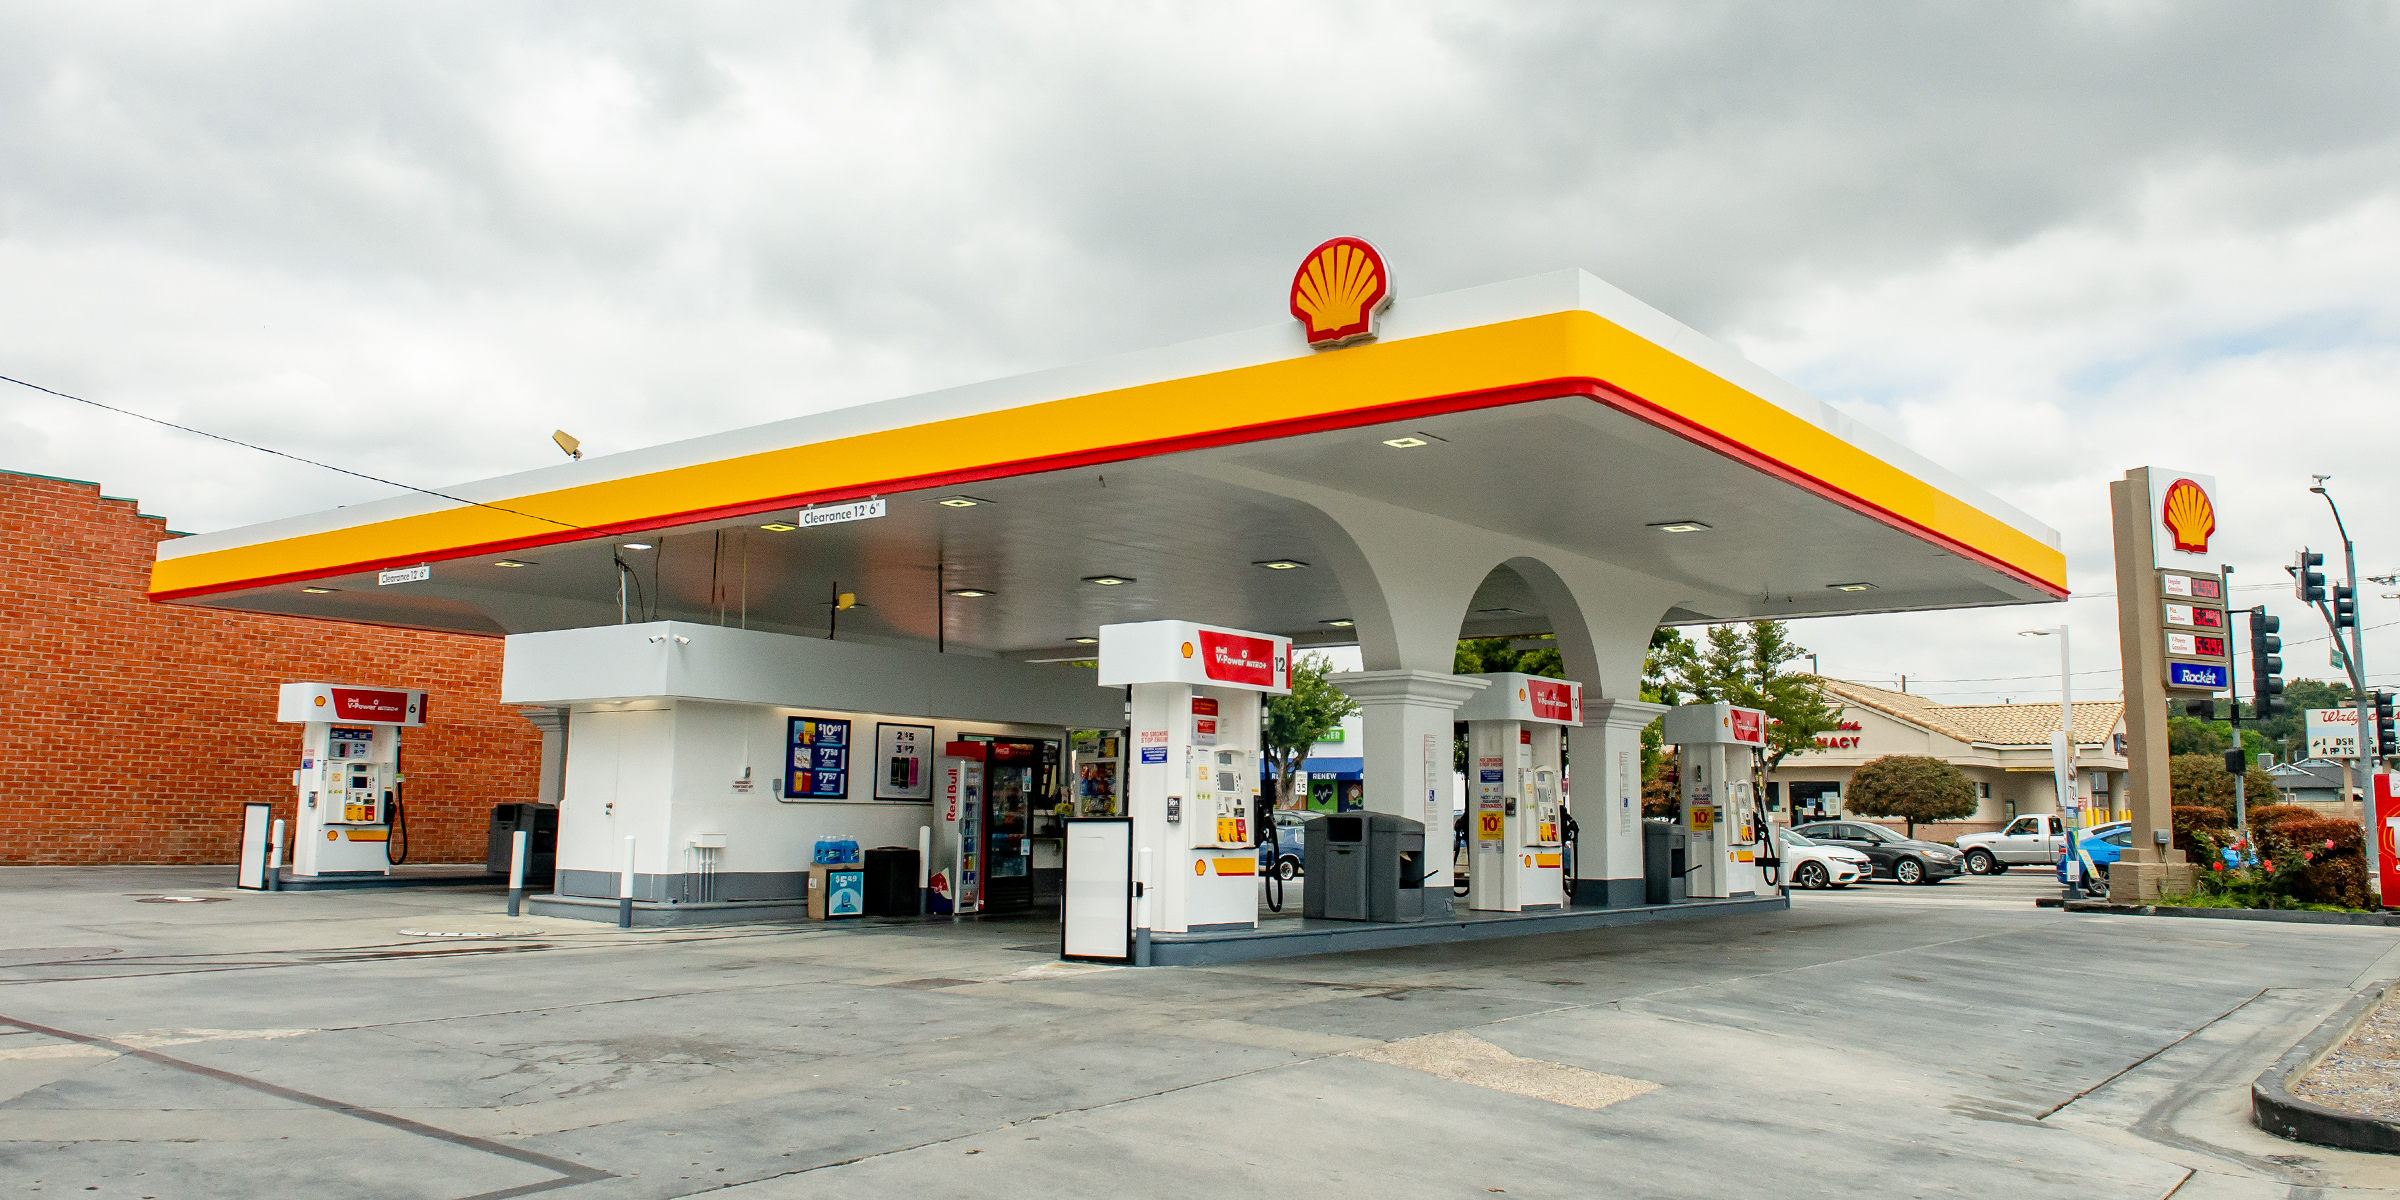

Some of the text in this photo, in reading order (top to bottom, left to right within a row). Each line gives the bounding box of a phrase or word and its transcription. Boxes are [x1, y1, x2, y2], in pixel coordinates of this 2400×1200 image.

[804, 510, 851, 524] Clearance
[382, 573, 409, 583] Clearance
[1215, 645, 1228, 654] Shell
[1215, 653, 1245, 666] V-Power
[1274, 656, 1286, 673] 12
[2181, 669, 2217, 685] Rocket
[408, 703, 416, 714] 6
[1571, 698, 1579, 710] 10
[1312, 772, 1337, 780] RENEW
[1296, 783, 1307, 793] 35
[946, 768, 958, 822] Red Bull
